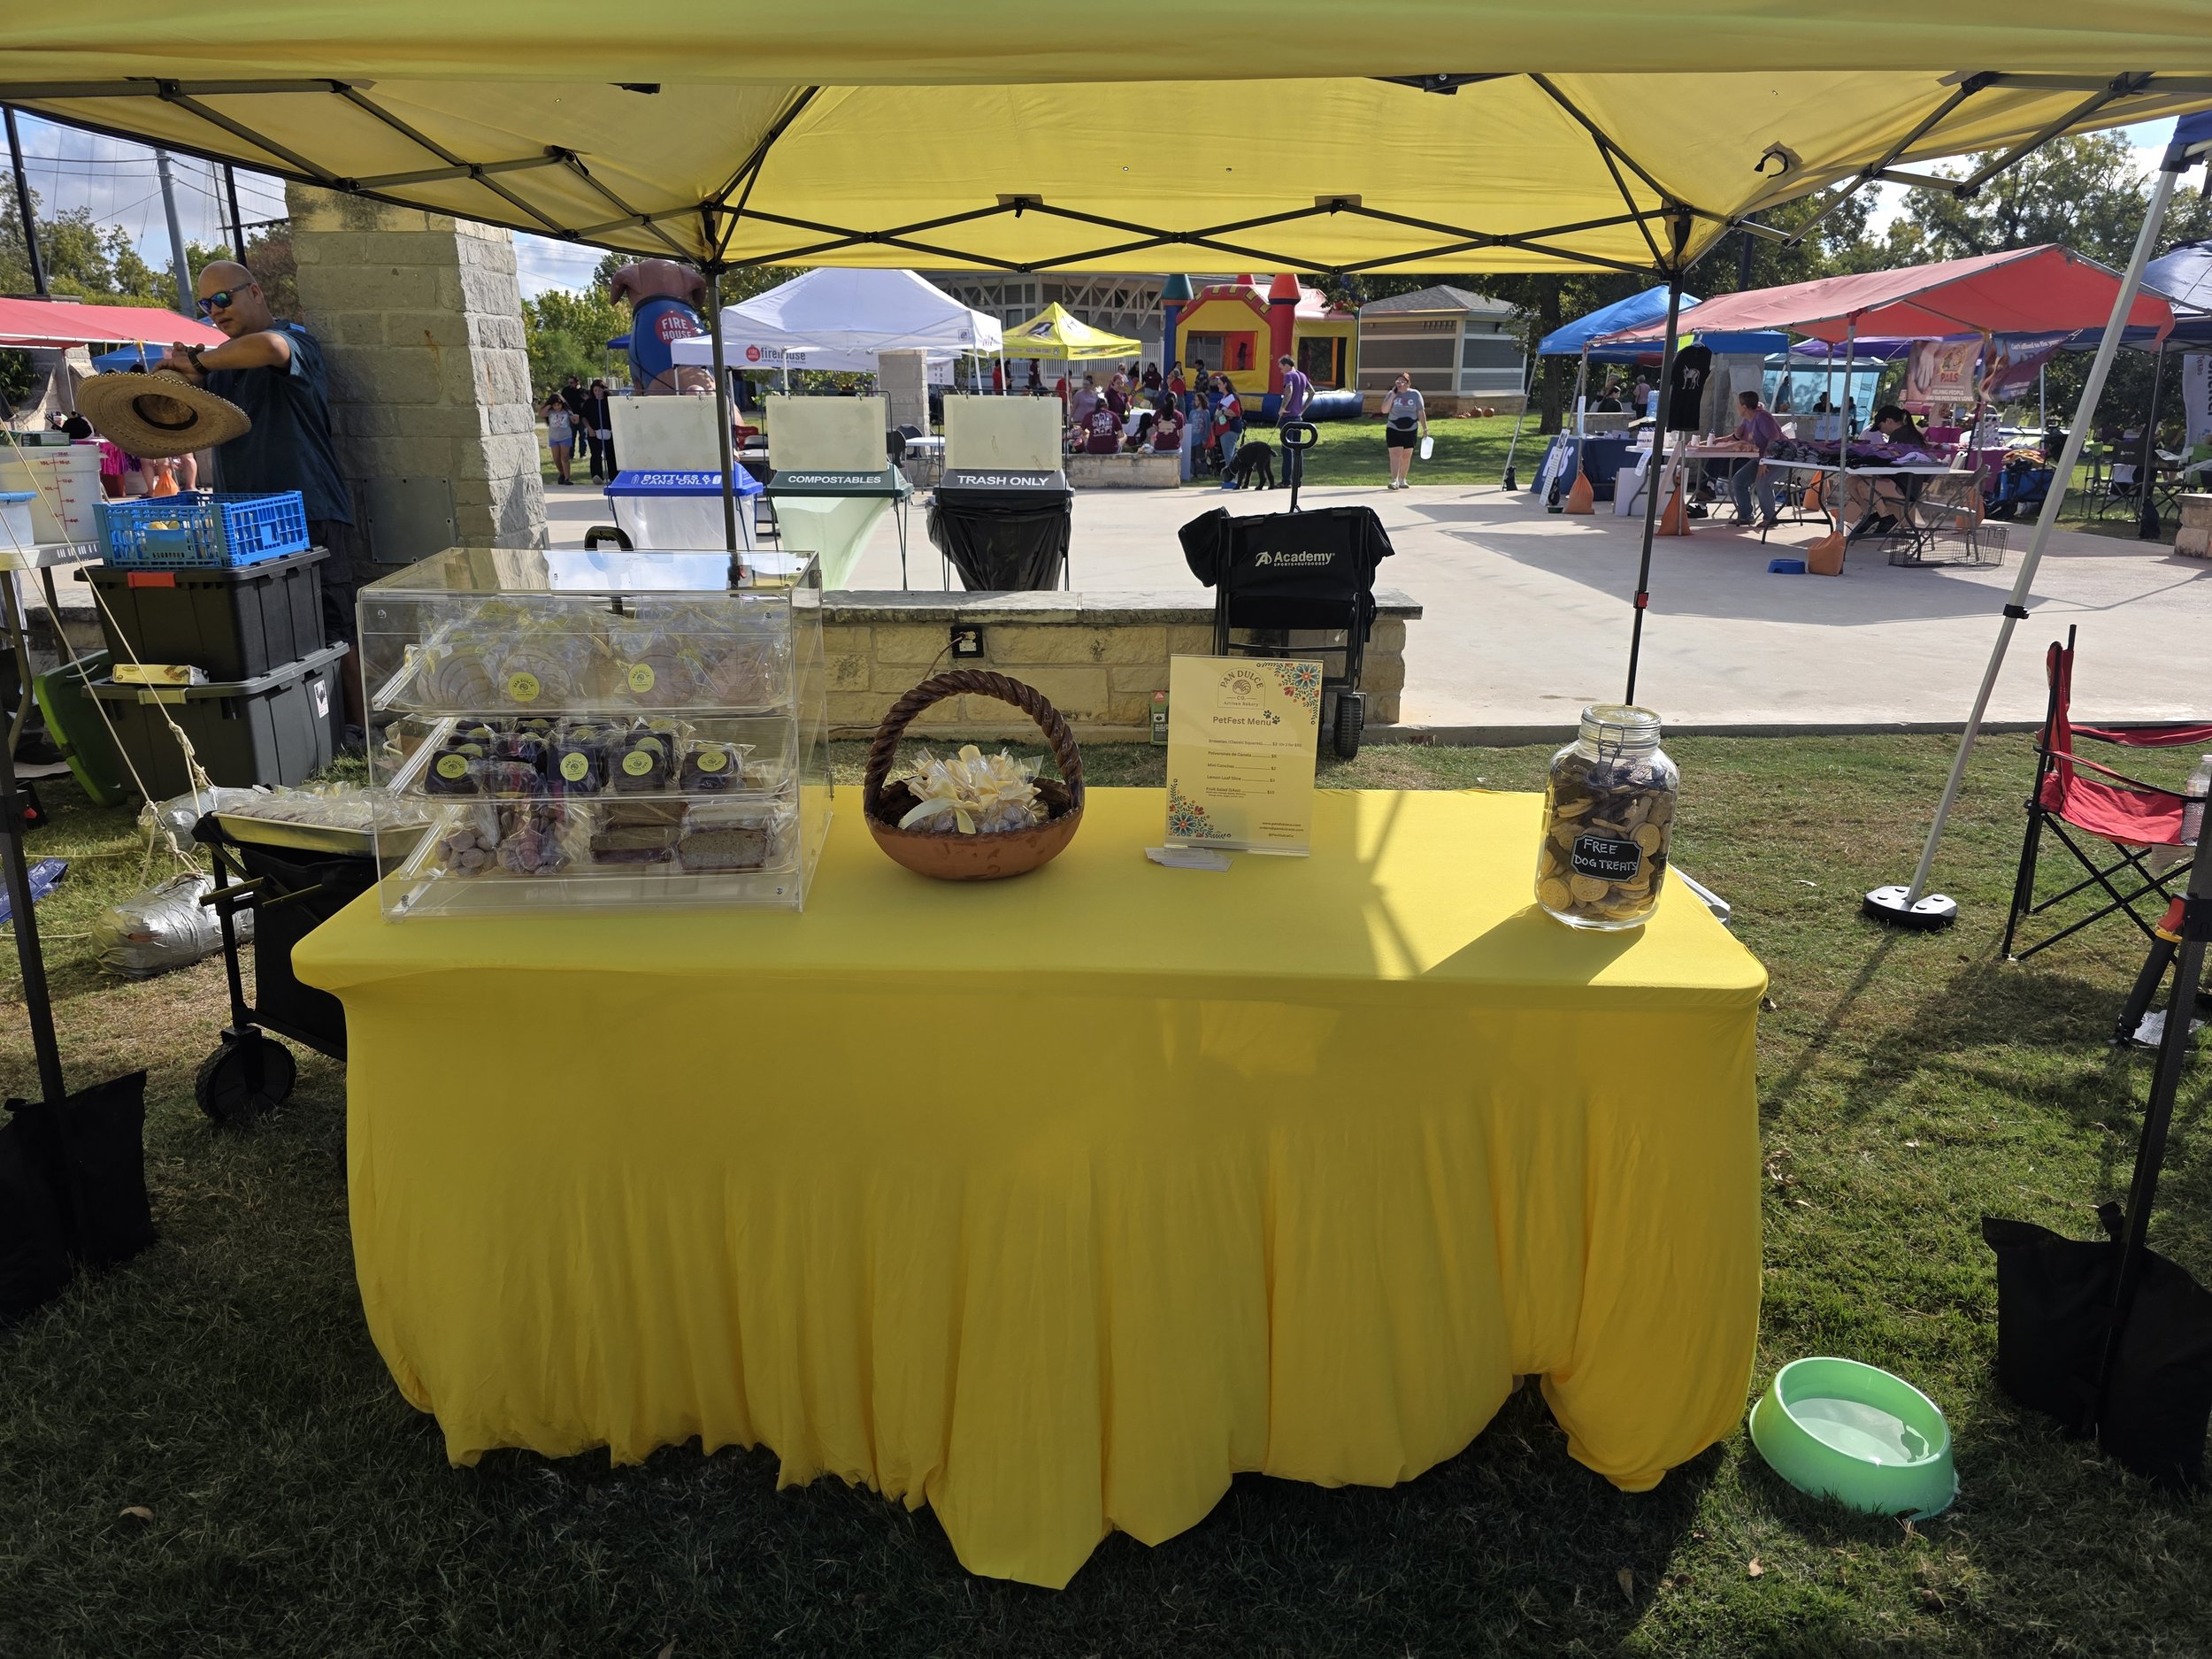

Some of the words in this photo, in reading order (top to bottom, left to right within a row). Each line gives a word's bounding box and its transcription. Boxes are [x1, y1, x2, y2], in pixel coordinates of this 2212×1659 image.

[661, 317, 688, 330] FIRE
[662, 330, 692, 341] HOUSE
[787, 475, 881, 484] COMPOSTABLES
[956, 475, 1007, 485] TRASH
[1010, 477, 1049, 486] ONLY
[1274, 550, 1333, 565] Academy
[1220, 672, 1235, 687] PAN
[1237, 670, 1263, 688] DULCE
[1213, 716, 1246, 725] PetFest
[1583, 838, 1618, 855] FREE
[1574, 854, 1597, 868] DOG
[1598, 859, 1637, 872] TREATS
